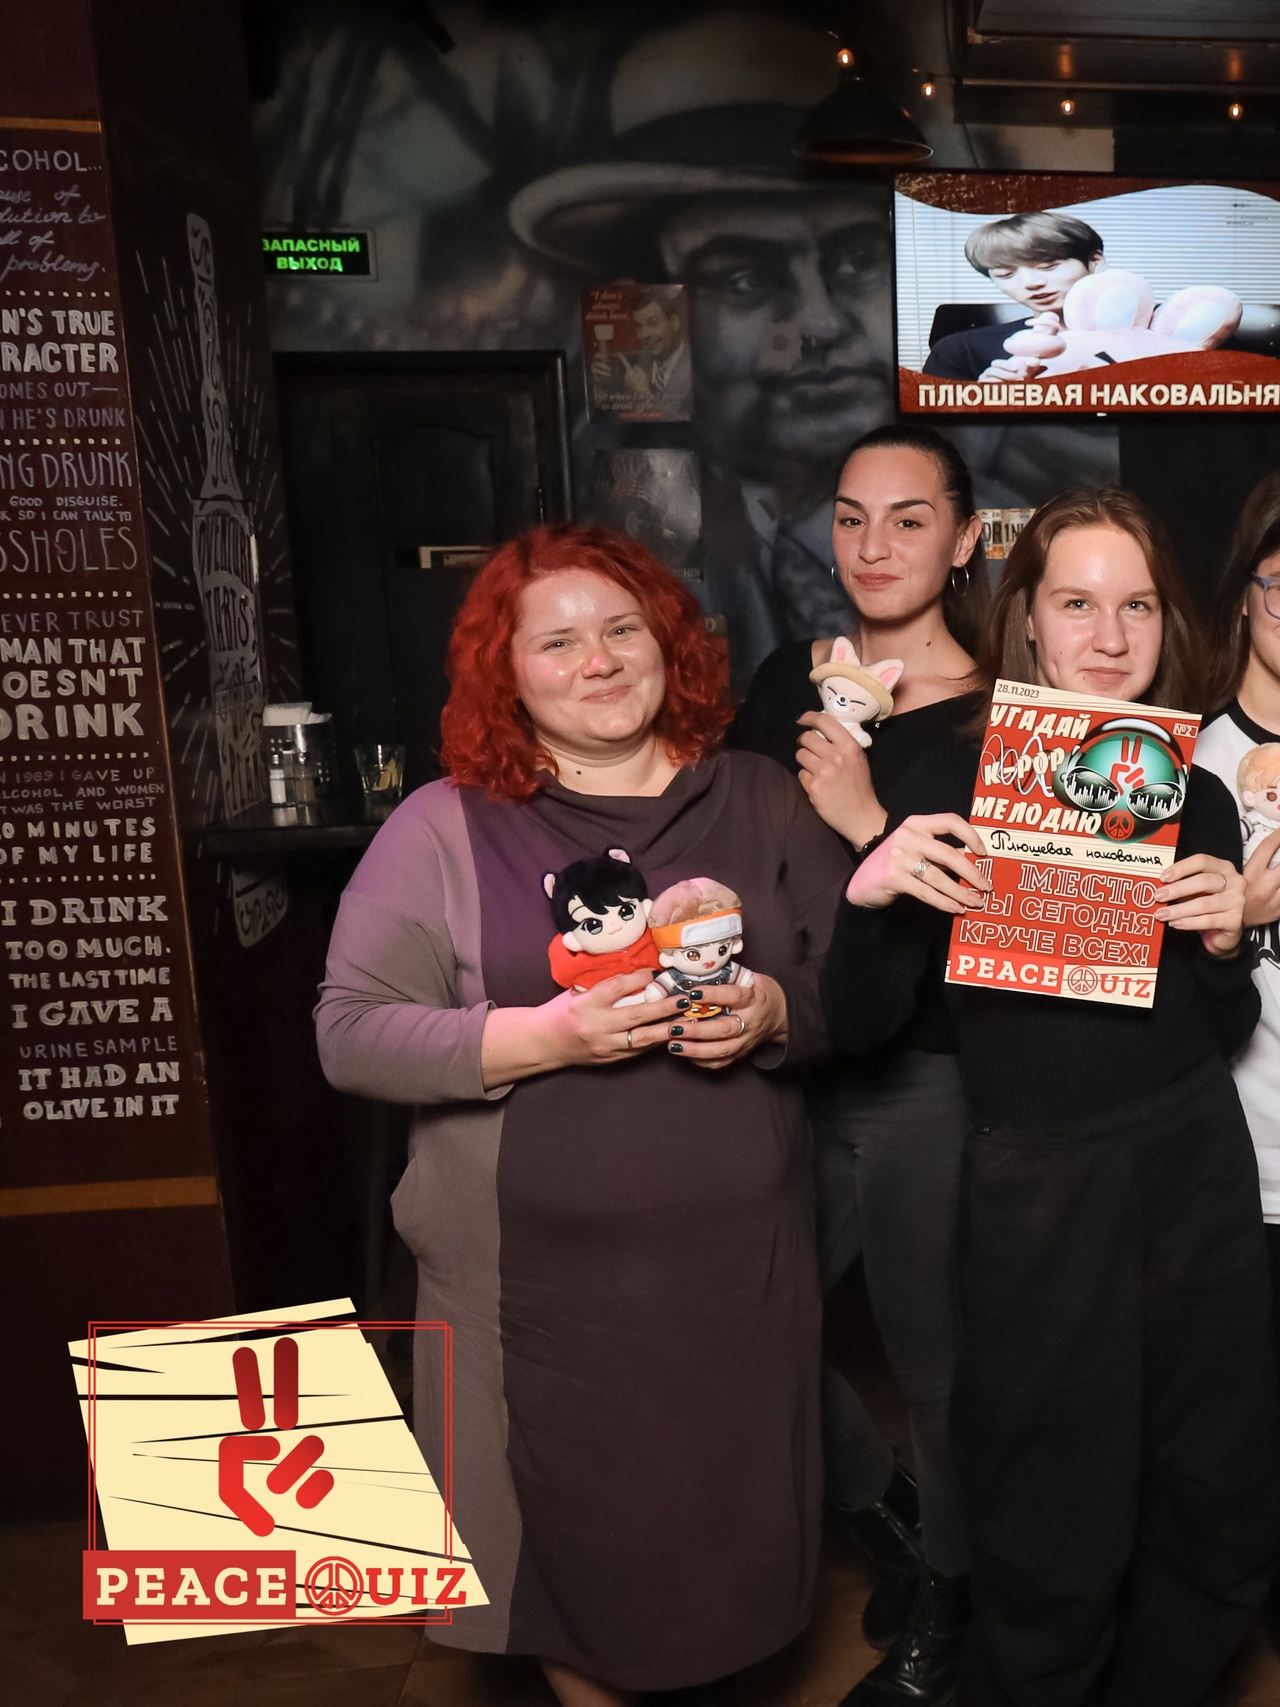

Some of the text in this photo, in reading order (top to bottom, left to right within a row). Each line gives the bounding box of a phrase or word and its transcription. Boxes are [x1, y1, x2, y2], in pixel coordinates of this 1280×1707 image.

[261, 236, 360, 252] ЗАПАСНЫЙ
[276, 256, 343, 272] ВЫХОД
[51, 309, 115, 336] TRUE
[0, 341, 119, 374] RACTER
[918, 383, 1280, 407] ПЛЮШЕВАЯ НАКОВАЛЬНЯ
[12, 407, 57, 430] HE'S
[63, 406, 126, 428] DRUNK
[41, 451, 133, 489] DRUNK
[9, 495, 123, 507] GOOD DISGUISE.
[18, 510, 36, 521] SO
[41, 511, 47, 520] I
[53, 510, 78, 521] CAN
[83, 510, 116, 522] TALK
[115, 510, 132, 522] TO
[1, 608, 144, 633] EVER TRUST
[0, 636, 146, 665] MAN THAT
[2, 667, 144, 699] OESN'T
[997, 683, 1040, 699] 28.11.2023
[990, 704, 1091, 740] УГАДАЙ
[59, 770, 65, 781] I
[72, 769, 121, 782] GAVE
[133, 766, 155, 780] UP
[76, 786, 106, 798] AND
[114, 783, 165, 795] WOMEN
[11, 803, 44, 815] WAS
[51, 800, 85, 812] THE
[96, 796, 157, 811] WORST
[971, 796, 1102, 835] МЕЛОДИЮ
[27, 816, 157, 839] MINUTES
[38, 844, 79, 865] MY
[92, 842, 153, 864] LIFE
[990, 829, 1163, 867] Плюшевая наковальня
[1017, 863, 1158, 908] МЕСТО
[1, 895, 169, 926] I DRINK
[1019, 896, 1155, 936] СЕГОДНЯ
[5, 935, 171, 961] TOO MUCH.
[959, 919, 1151, 967] КРУЧЕ ВСЕХ!
[8, 966, 171, 990] THE LAST TIME
[956, 954, 1060, 988] PEACE
[11, 996, 174, 1029] I GAVE A
[19, 1035, 178, 1059] URINE SAMPLE
[18, 1061, 180, 1092] IT HAD AN
[23, 1094, 180, 1120] OLIVE IN IT
